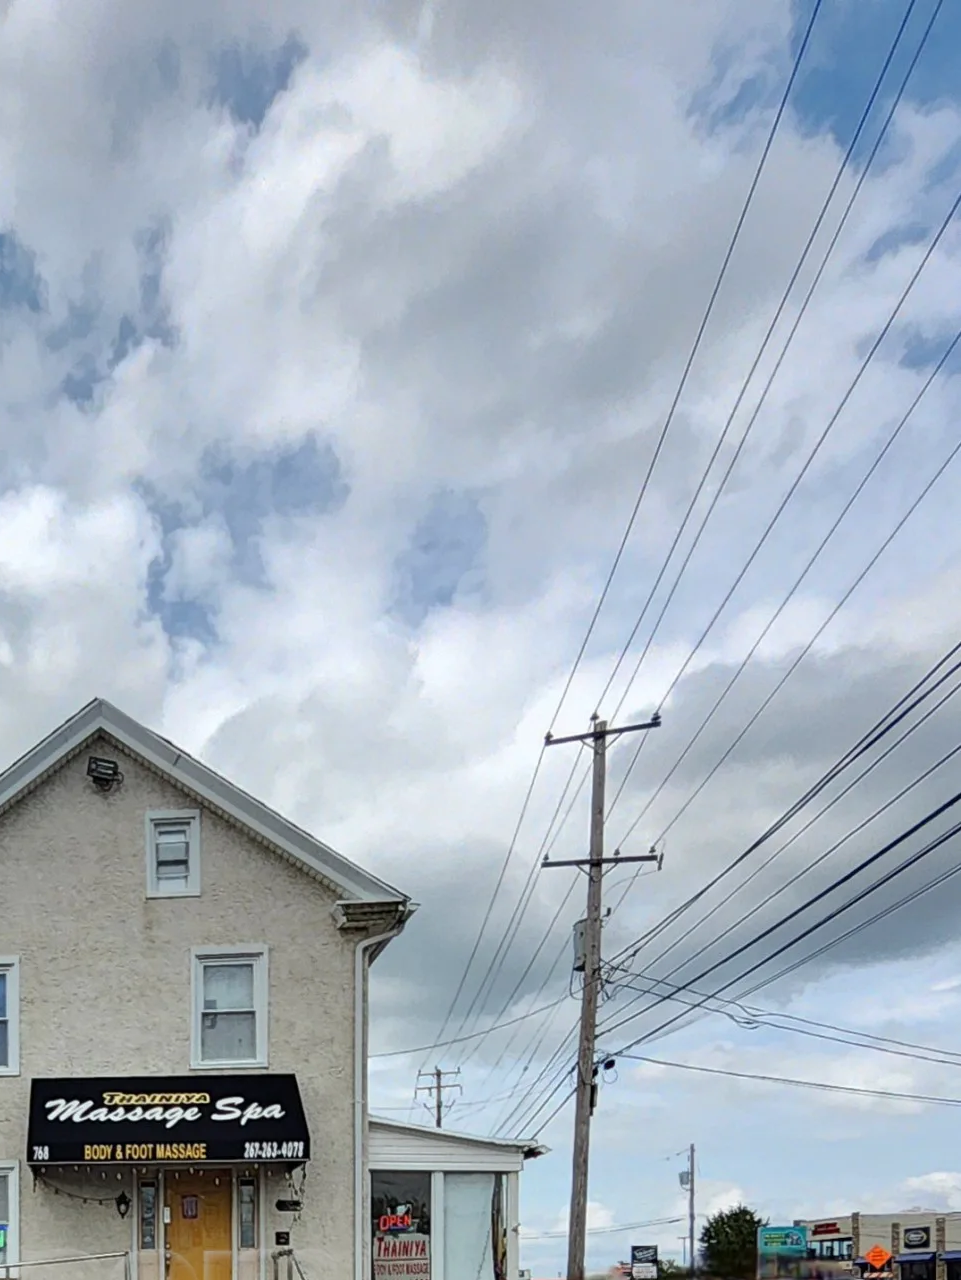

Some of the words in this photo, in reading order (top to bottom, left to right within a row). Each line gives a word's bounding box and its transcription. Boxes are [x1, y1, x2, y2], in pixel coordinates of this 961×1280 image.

[103, 1092, 210, 1105] THAINIYA
[45, 1098, 202, 1128] Massage
[211, 1097, 285, 1126] Spa
[33, 1146, 49, 1160] 768
[84, 1144, 112, 1160] BODY
[115, 1145, 124, 1159] &
[125, 1144, 154, 1159] FOOT
[156, 1143, 207, 1159] MASSAGE
[380, 1215, 412, 1231] OPEN
[377, 1237, 426, 1257] THAINIYA
